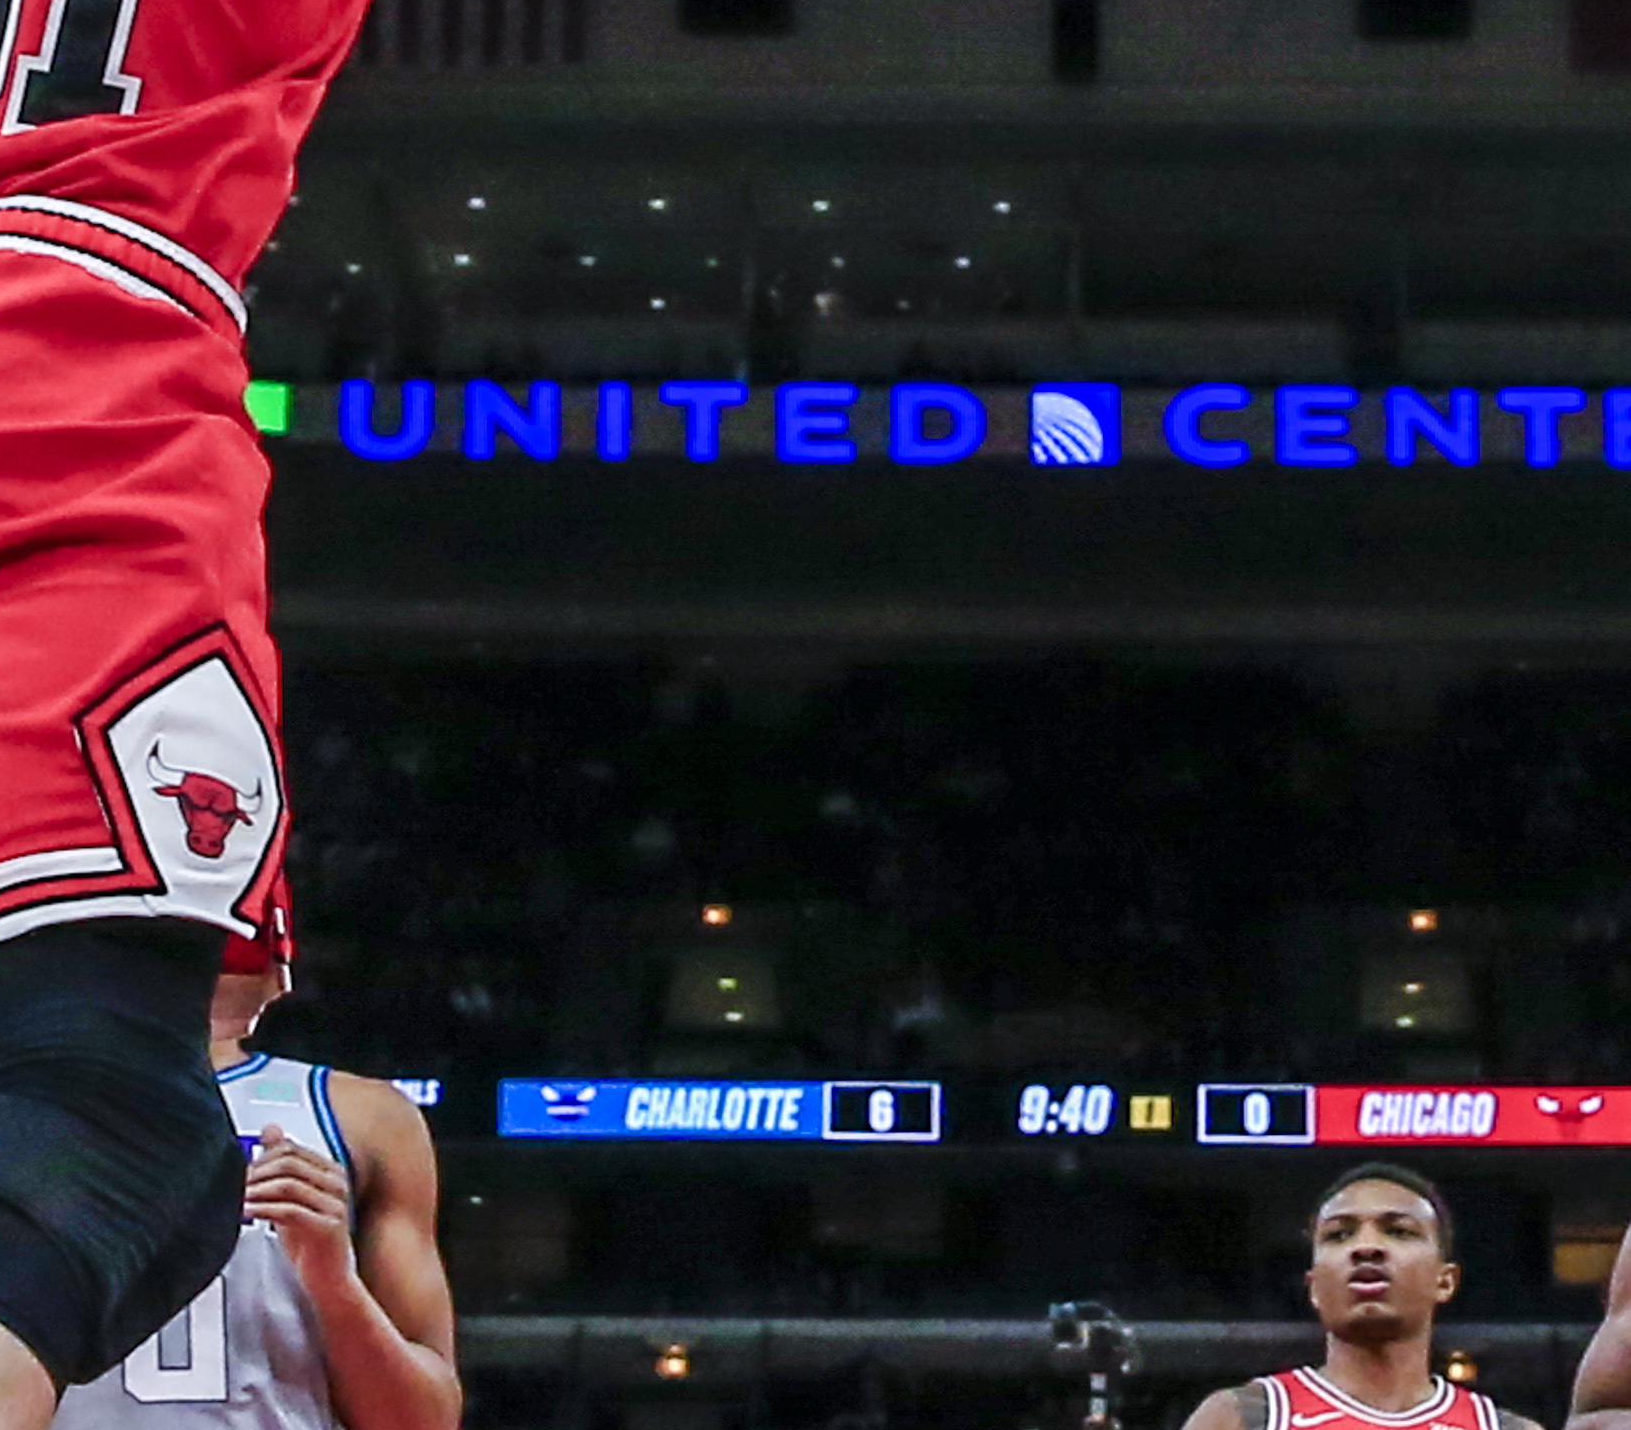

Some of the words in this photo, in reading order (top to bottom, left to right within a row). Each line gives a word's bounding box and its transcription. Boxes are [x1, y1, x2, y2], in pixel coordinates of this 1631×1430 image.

[340, 379, 988, 466] UNITED
[624, 1086, 804, 1132] CHARLOTTE
[868, 1089, 896, 1132] 6
[1018, 1084, 1113, 1135] 9:40
[1243, 1091, 1270, 1136] 0
[1357, 1090, 1499, 1138] CHICAGO
